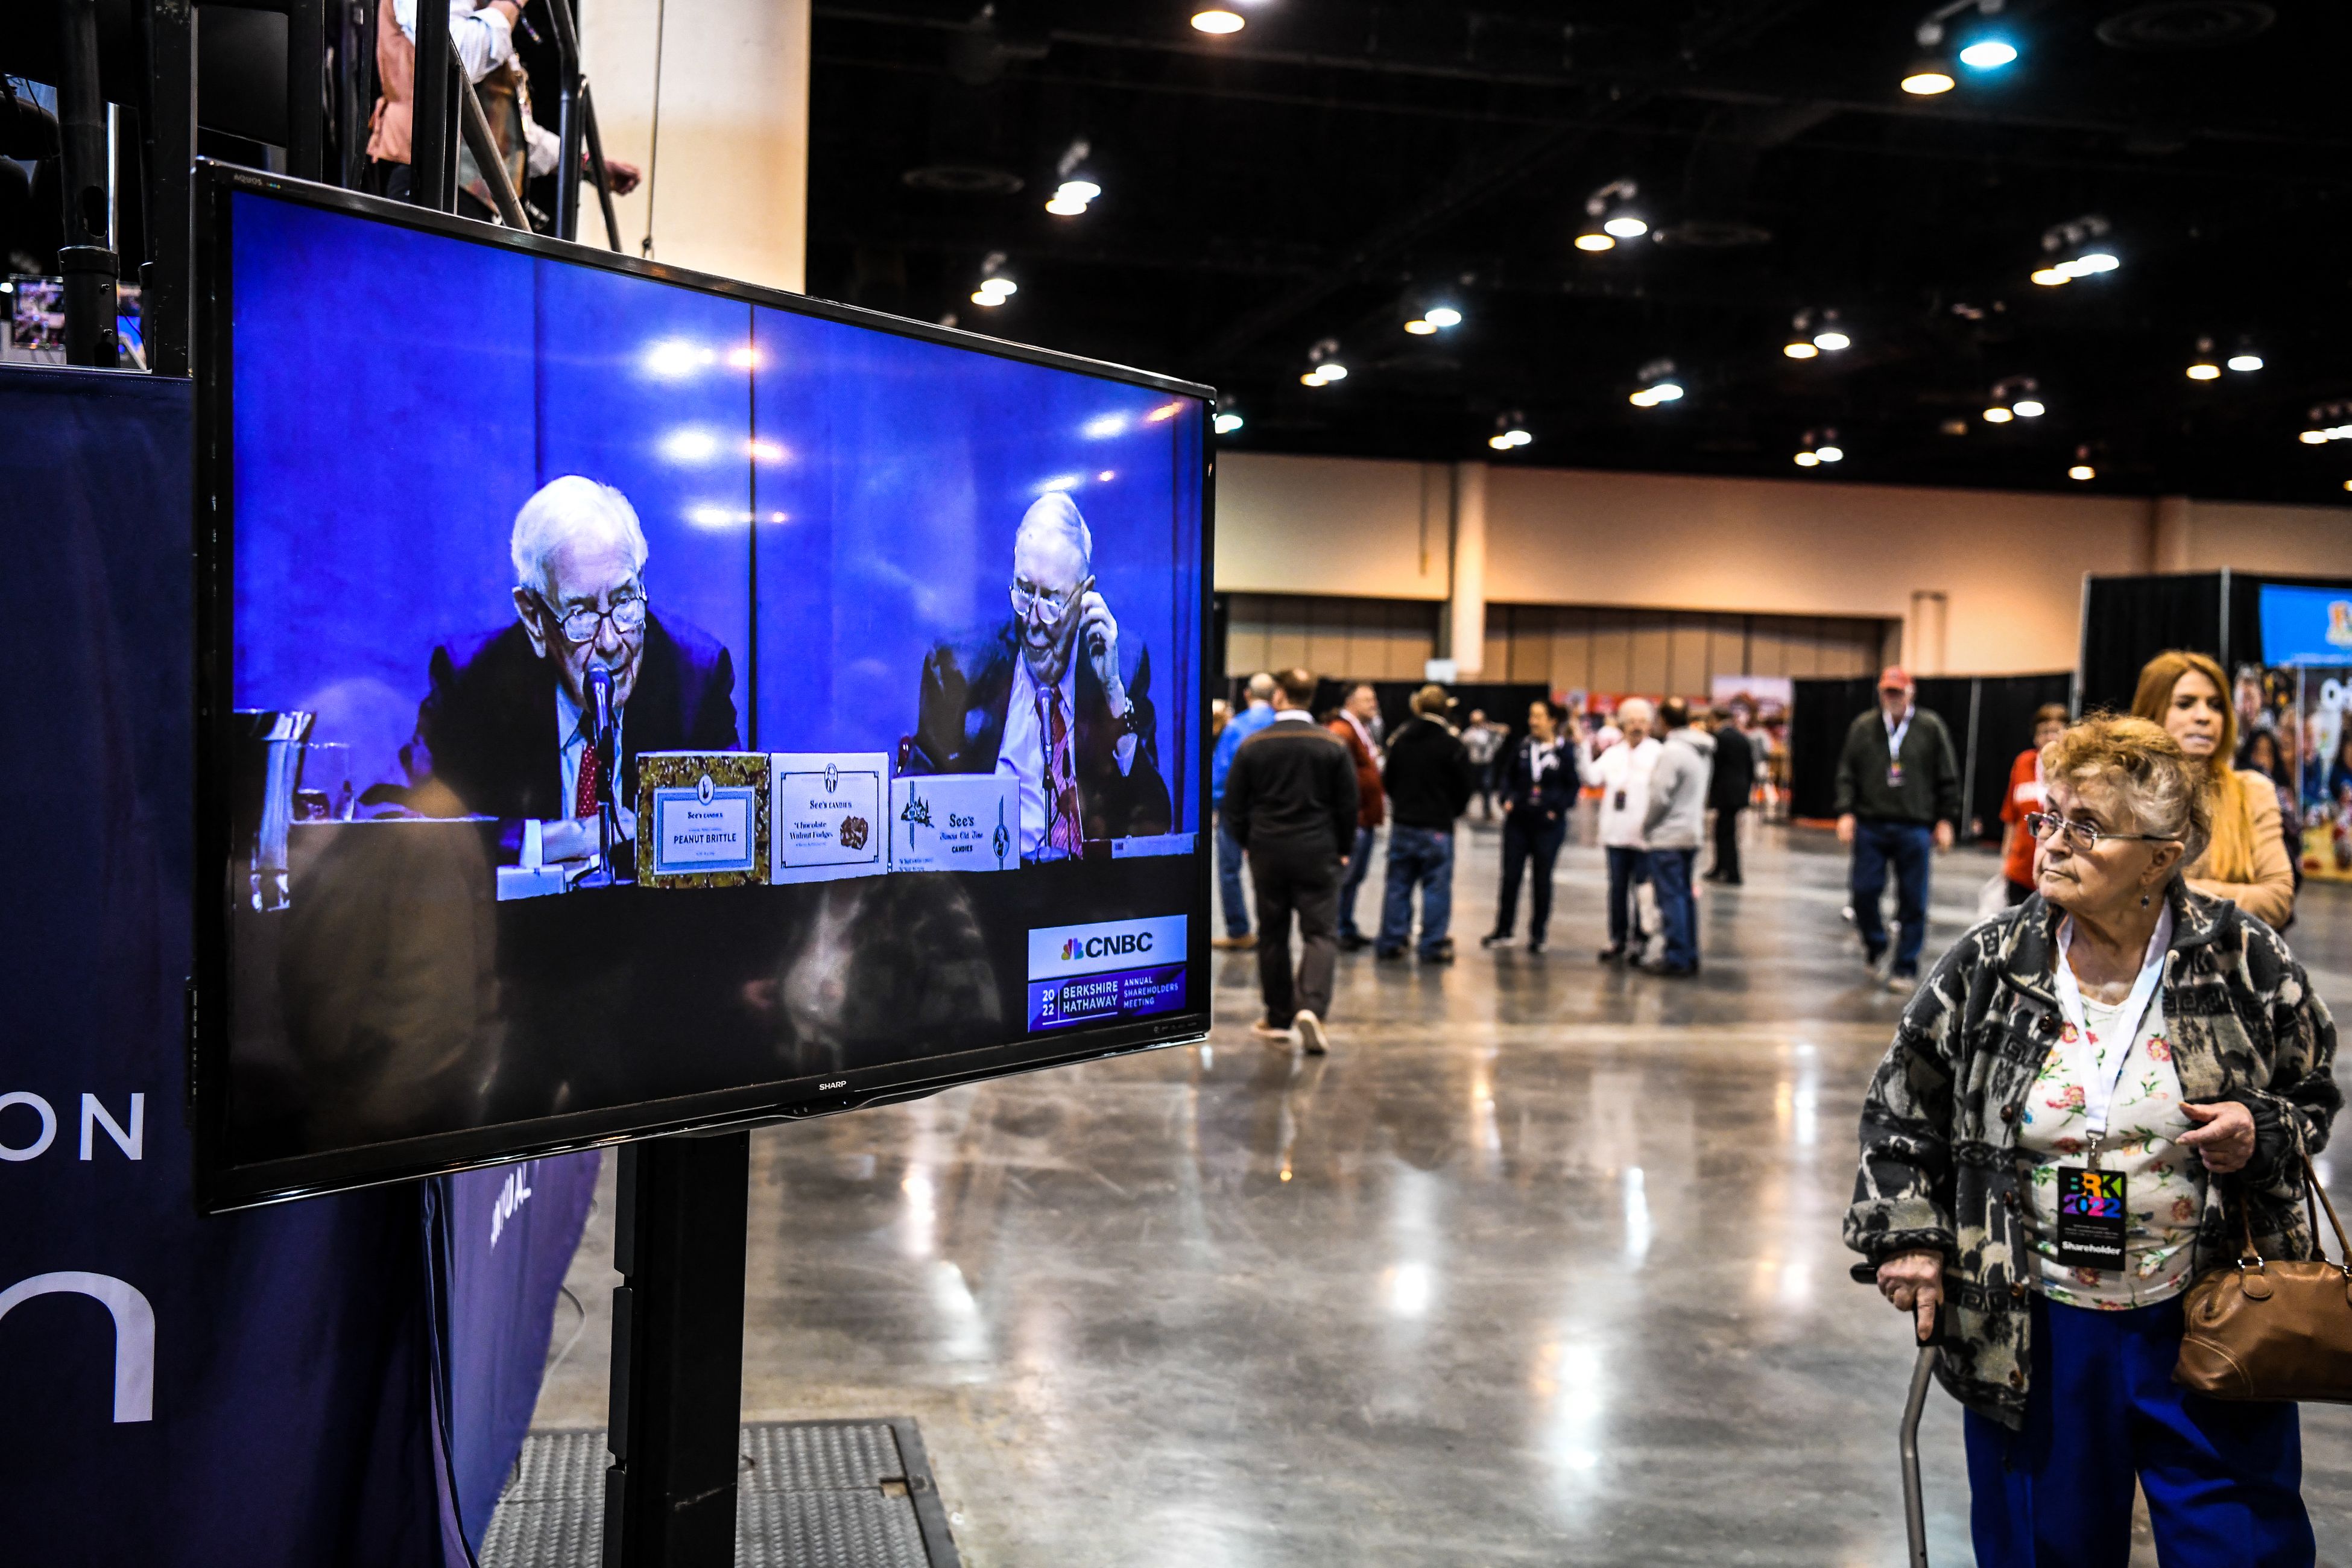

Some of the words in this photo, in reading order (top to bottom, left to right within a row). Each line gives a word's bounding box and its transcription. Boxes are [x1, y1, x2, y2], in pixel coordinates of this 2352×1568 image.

[794, 821, 826, 829] Chocolate
[949, 814, 974, 827] See's
[674, 835, 704, 844] PEANUT
[706, 833, 736, 843] BRITTLE
[1086, 932, 1152, 958] CNBC
[1124, 976, 1152, 987] ANNUAL
[1042, 989, 1055, 1002] 20
[1063, 981, 1118, 999] BERKSHIRE
[1124, 984, 1178, 998] SHAREHOLDERS
[1063, 995, 1118, 1013] HATHAWAY
[1124, 997, 1154, 1009] MEETING
[1042, 1004, 1055, 1016] 22
[819, 1081, 847, 1090] SHARP
[2069, 1172, 2122, 1198] BRK
[2063, 1193, 2122, 1218] 2022
[2061, 1241, 2122, 1256] Shareholder
